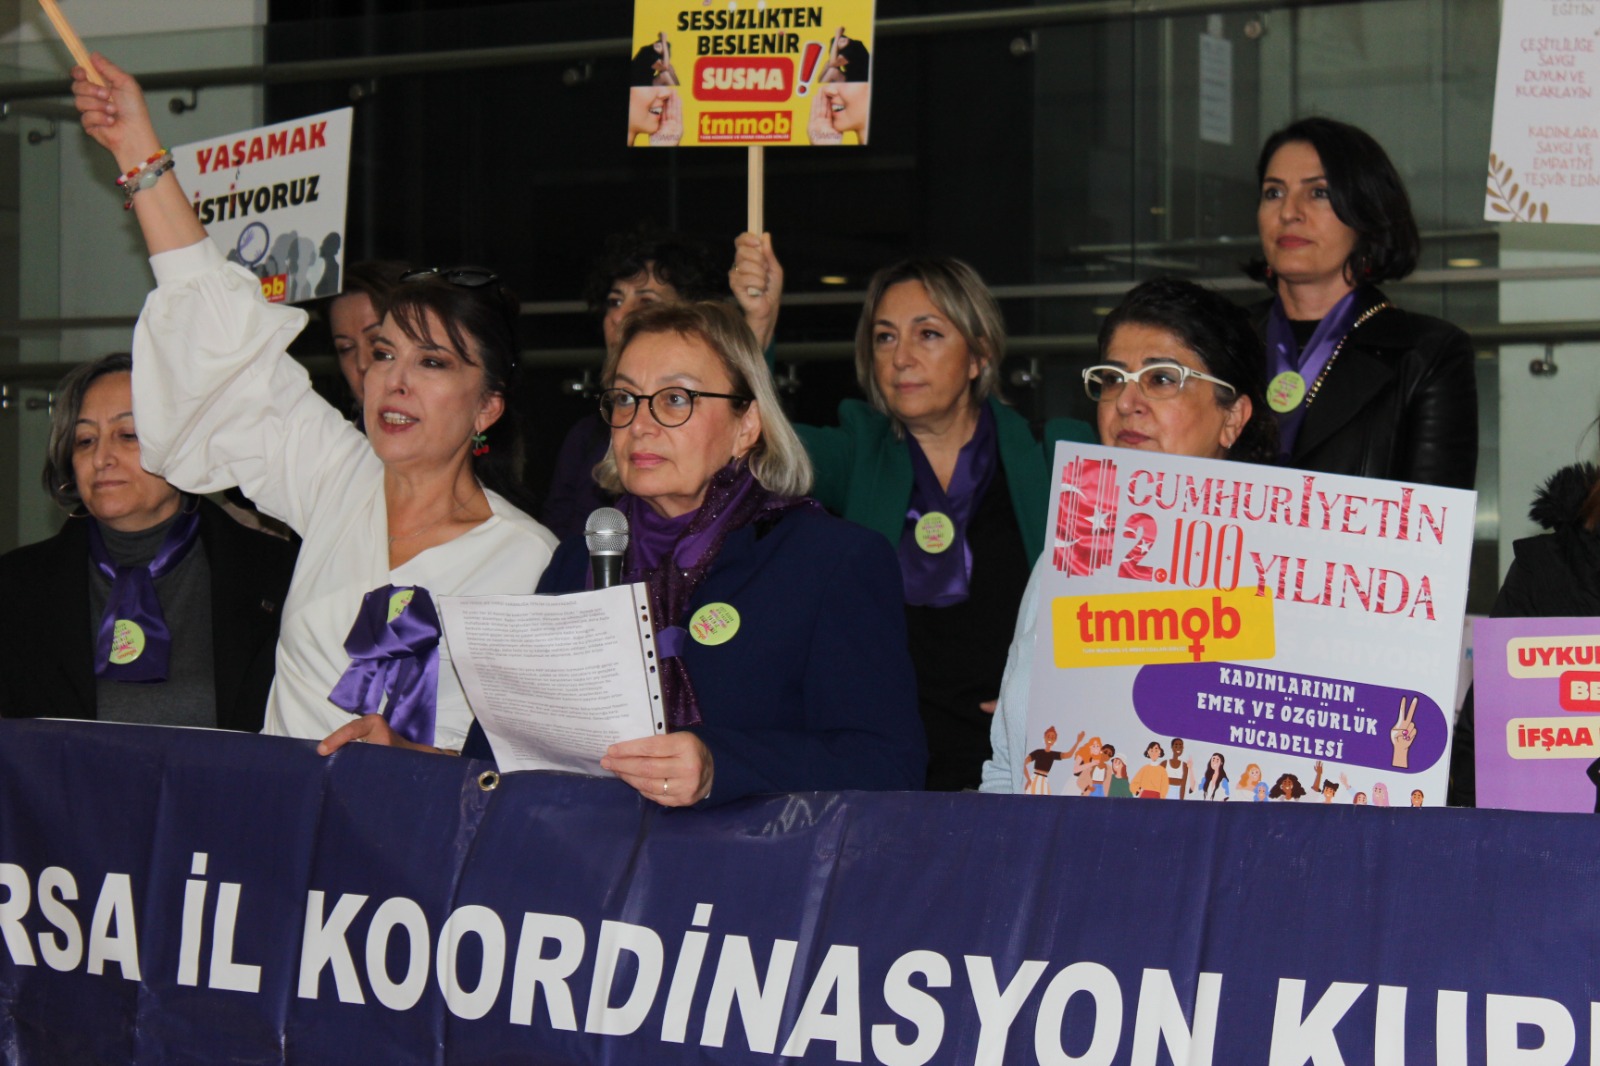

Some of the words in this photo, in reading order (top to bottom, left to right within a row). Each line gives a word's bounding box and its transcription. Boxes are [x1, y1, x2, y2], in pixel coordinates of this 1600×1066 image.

[701, 67, 784, 90] SUSMA
[1569, 70, 1585, 84] VE
[700, 113, 790, 135] tmmob
[1577, 142, 1593, 156] VE
[1126, 469, 1449, 545] CUMHURİYETİN
[1249, 551, 1439, 621] YILINDA
[1077, 597, 1242, 661] tmmob
[1517, 646, 1600, 667] UYKU
[1219, 667, 1356, 703] KADINLARININ
[1197, 692, 1246, 716] EMEK
[1251, 700, 1275, 721] VE
[1280, 696, 1378, 736] ÖZGÜRLÜK
[1229, 719, 1344, 760] MÜCADELESİ
[1517, 725, 1594, 751] İFŞAA
[177, 852, 262, 993] İL
[297, 889, 1223, 1066] KOORDİNASYON
[1269, 977, 1600, 1066] KUR
